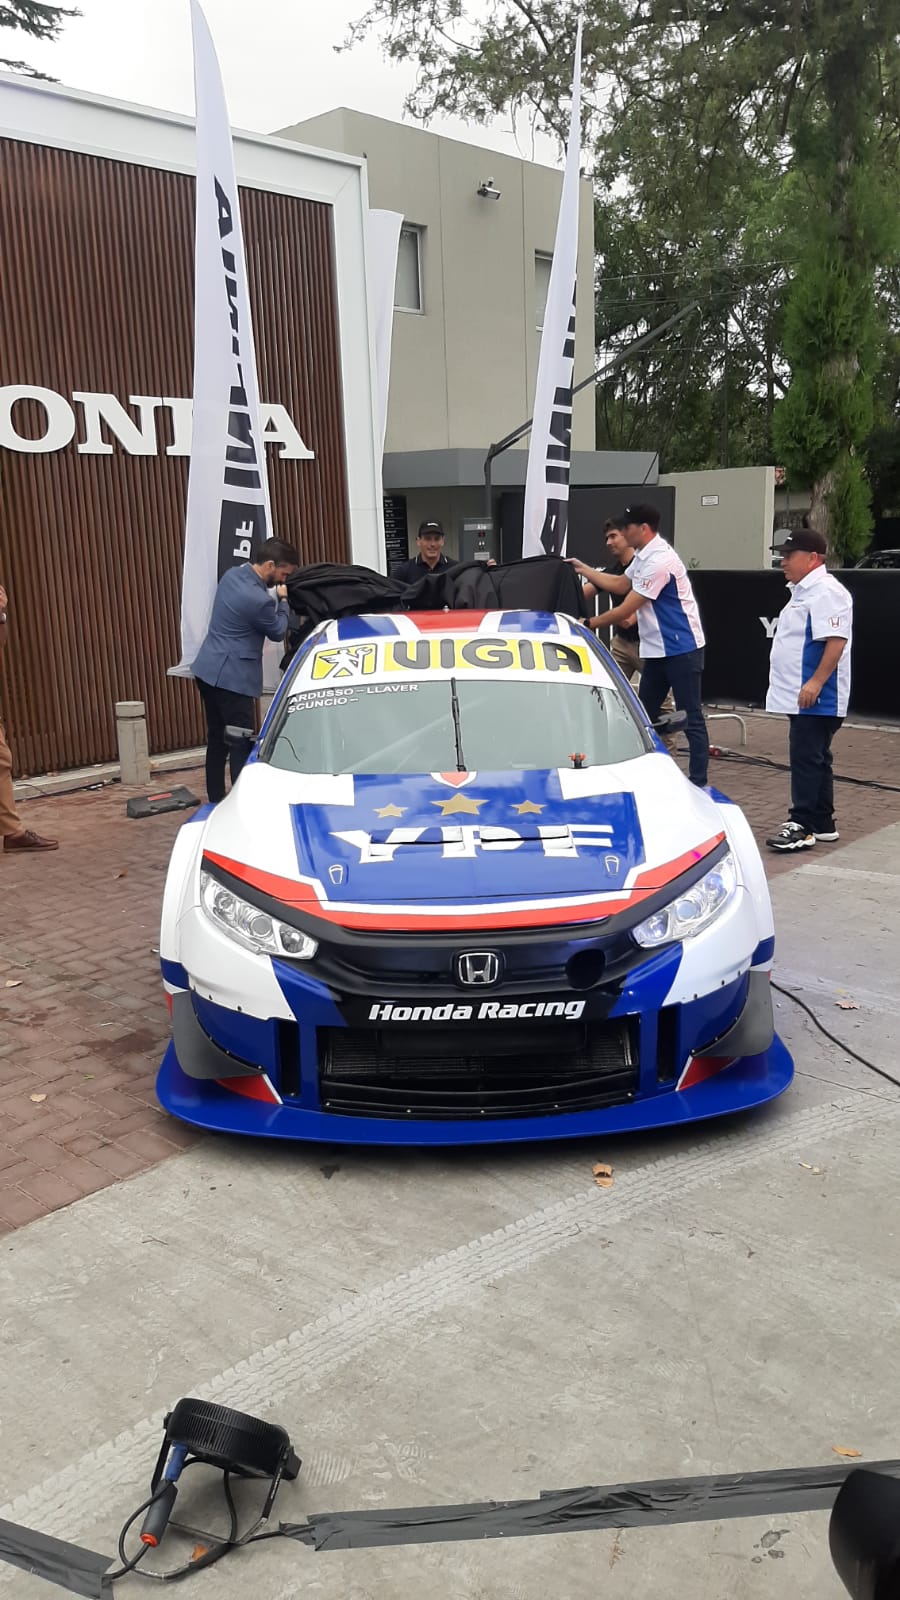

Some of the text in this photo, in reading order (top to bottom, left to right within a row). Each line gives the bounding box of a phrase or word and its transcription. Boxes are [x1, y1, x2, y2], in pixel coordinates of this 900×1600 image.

[289, 688, 354, 705] ARDUSSO
[366, 684, 419, 694] LLAVER
[287, 698, 348, 714] SCUNCIO
[328, 824, 614, 864] YPF
[368, 1000, 586, 1021] Honda Racing
